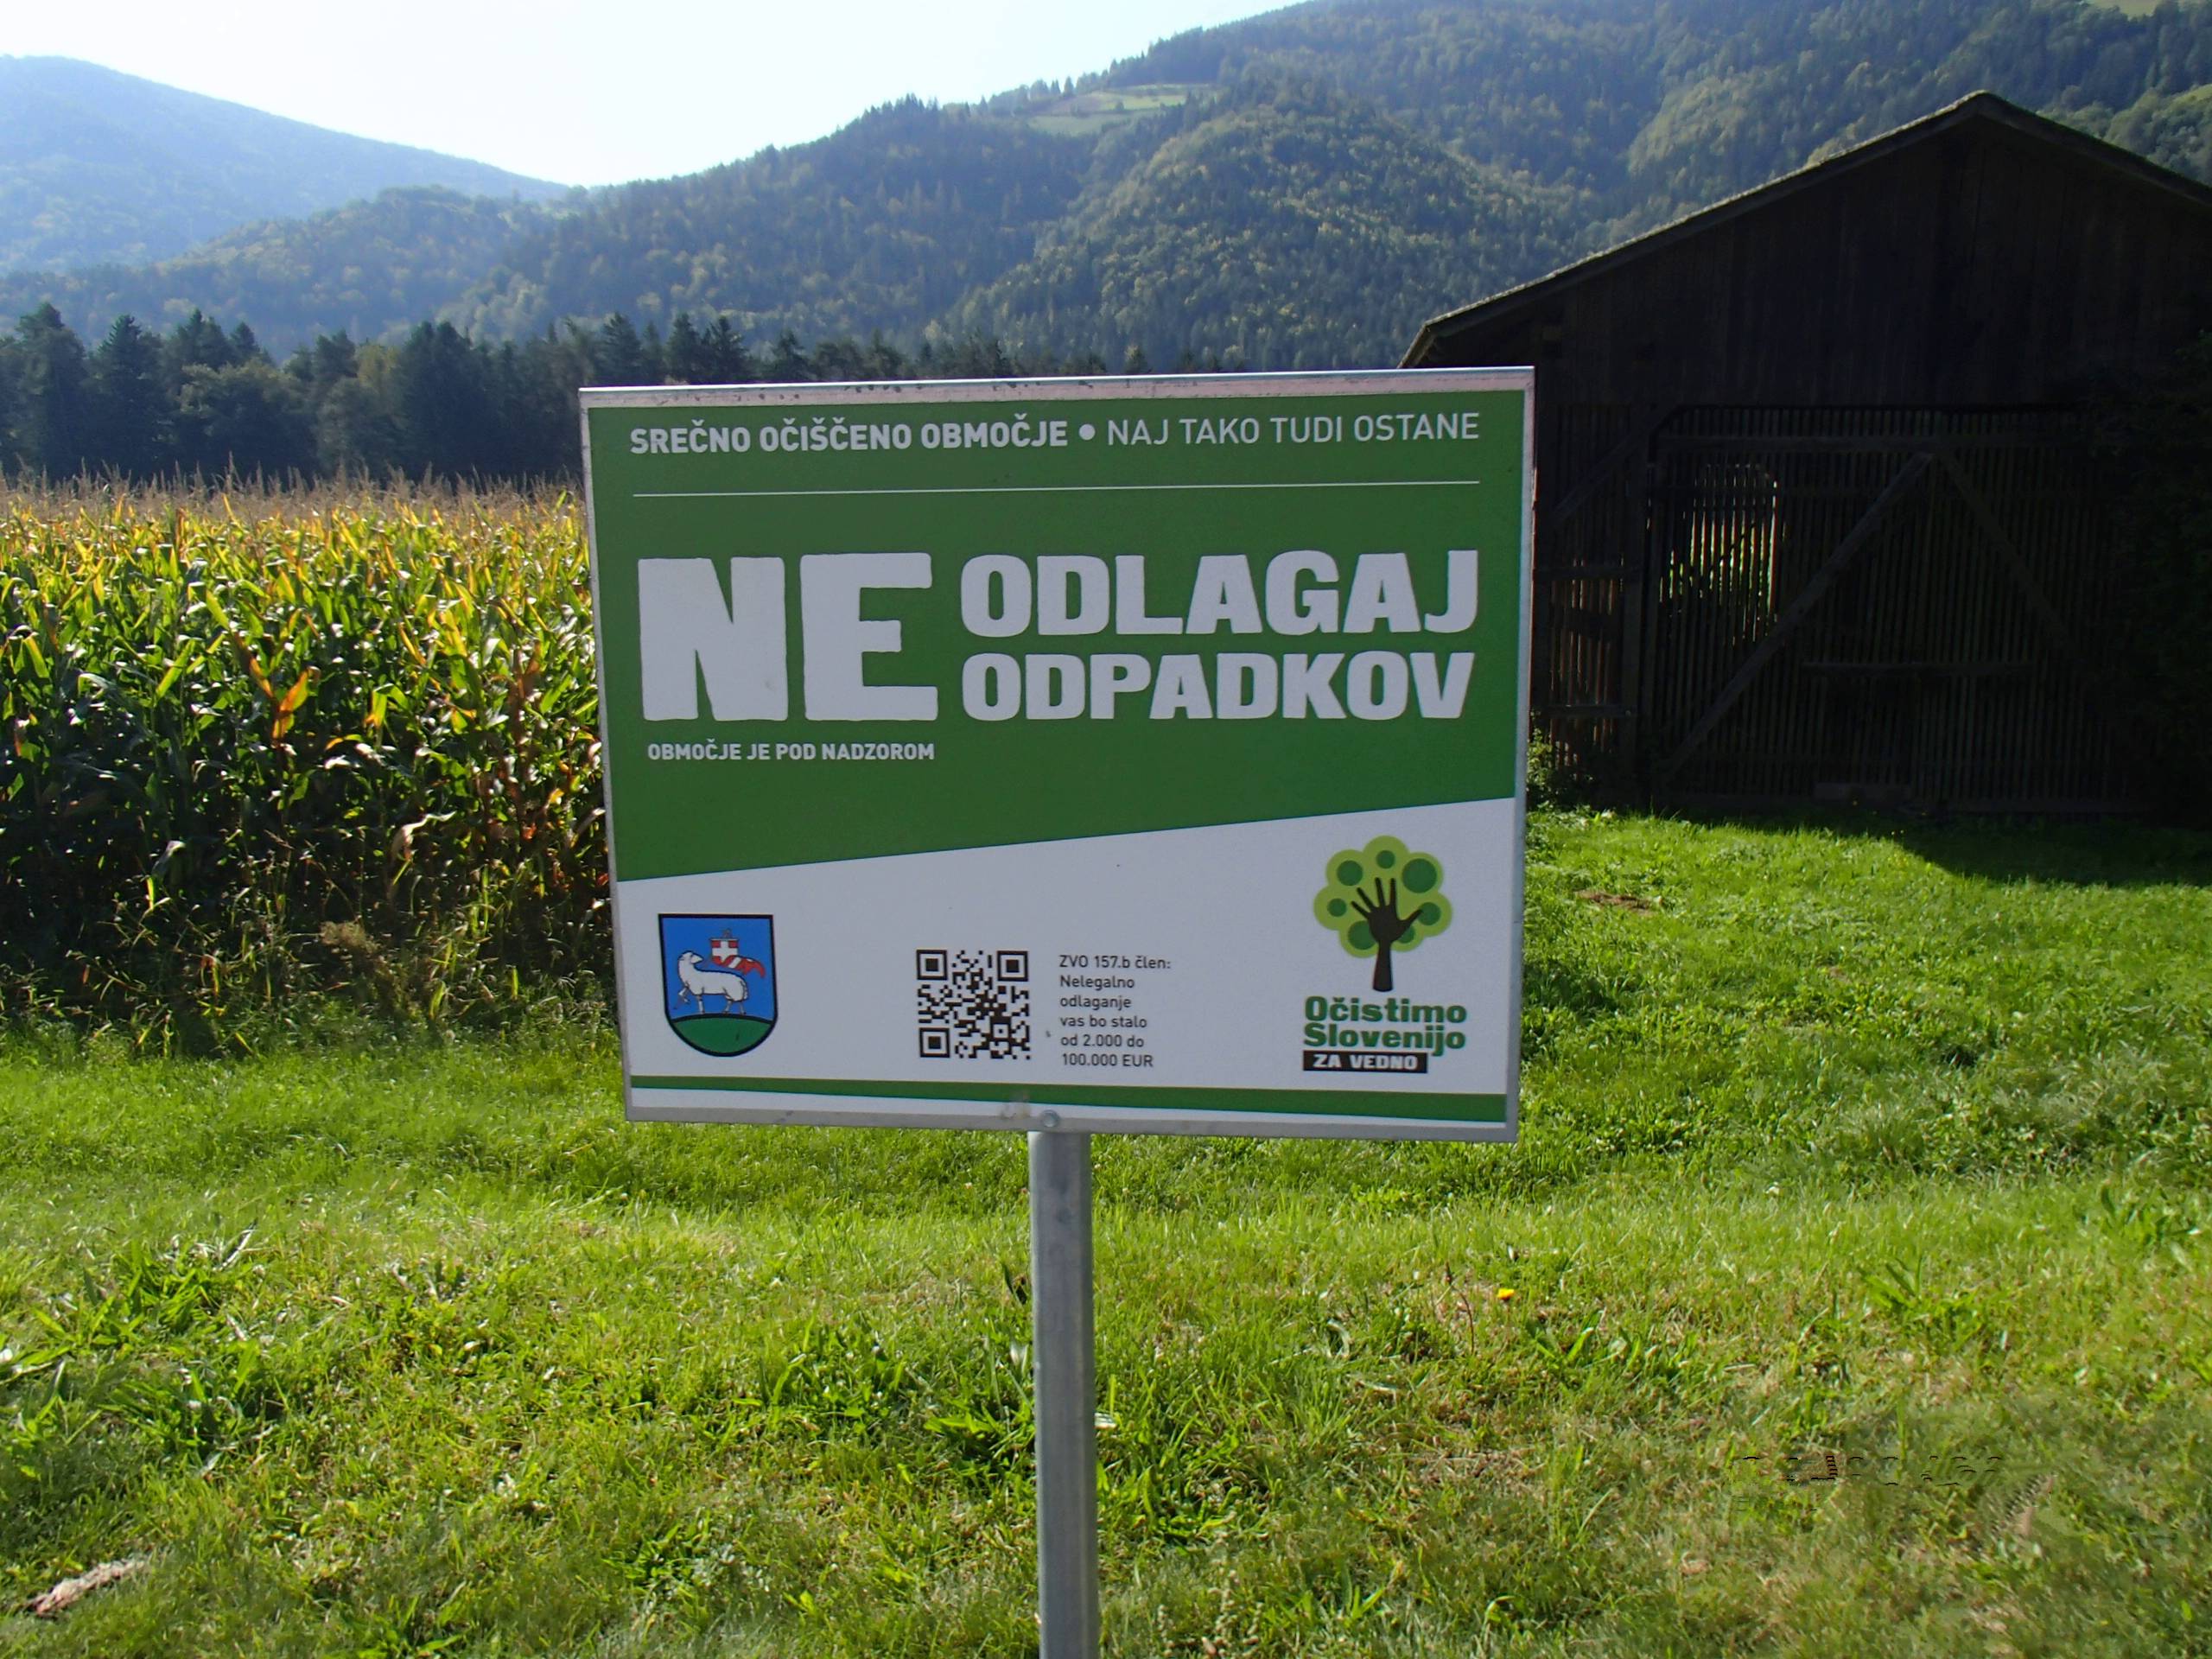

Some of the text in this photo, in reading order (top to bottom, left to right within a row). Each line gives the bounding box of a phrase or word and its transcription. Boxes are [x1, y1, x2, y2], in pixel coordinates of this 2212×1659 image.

[629, 412, 1480, 454] SREČNO OČIŠČENO OBMOČJE NAJ TAKO TUDI OSTANE
[961, 550, 1478, 637] ODLAGAJ
[638, 552, 938, 722] NE
[961, 651, 1475, 721] ODPADKOV
[647, 738, 935, 761] OBMOČJE JE POD NADZOROM
[1059, 955, 1171, 969] ZVO 157.b člen:
[1059, 976, 1135, 990] Nelegalno
[1060, 995, 1132, 1010] odlaganje
[1305, 996, 1467, 1022] Očistimo
[1060, 1015, 1147, 1028] vas bo stalo
[1061, 1034, 1145, 1047] od 2.000 do
[1303, 1023, 1465, 1056] Slovenijo
[1063, 1053, 1154, 1067] 100.000 EUR
[1313, 1054, 1418, 1070] ZA VEDNO
